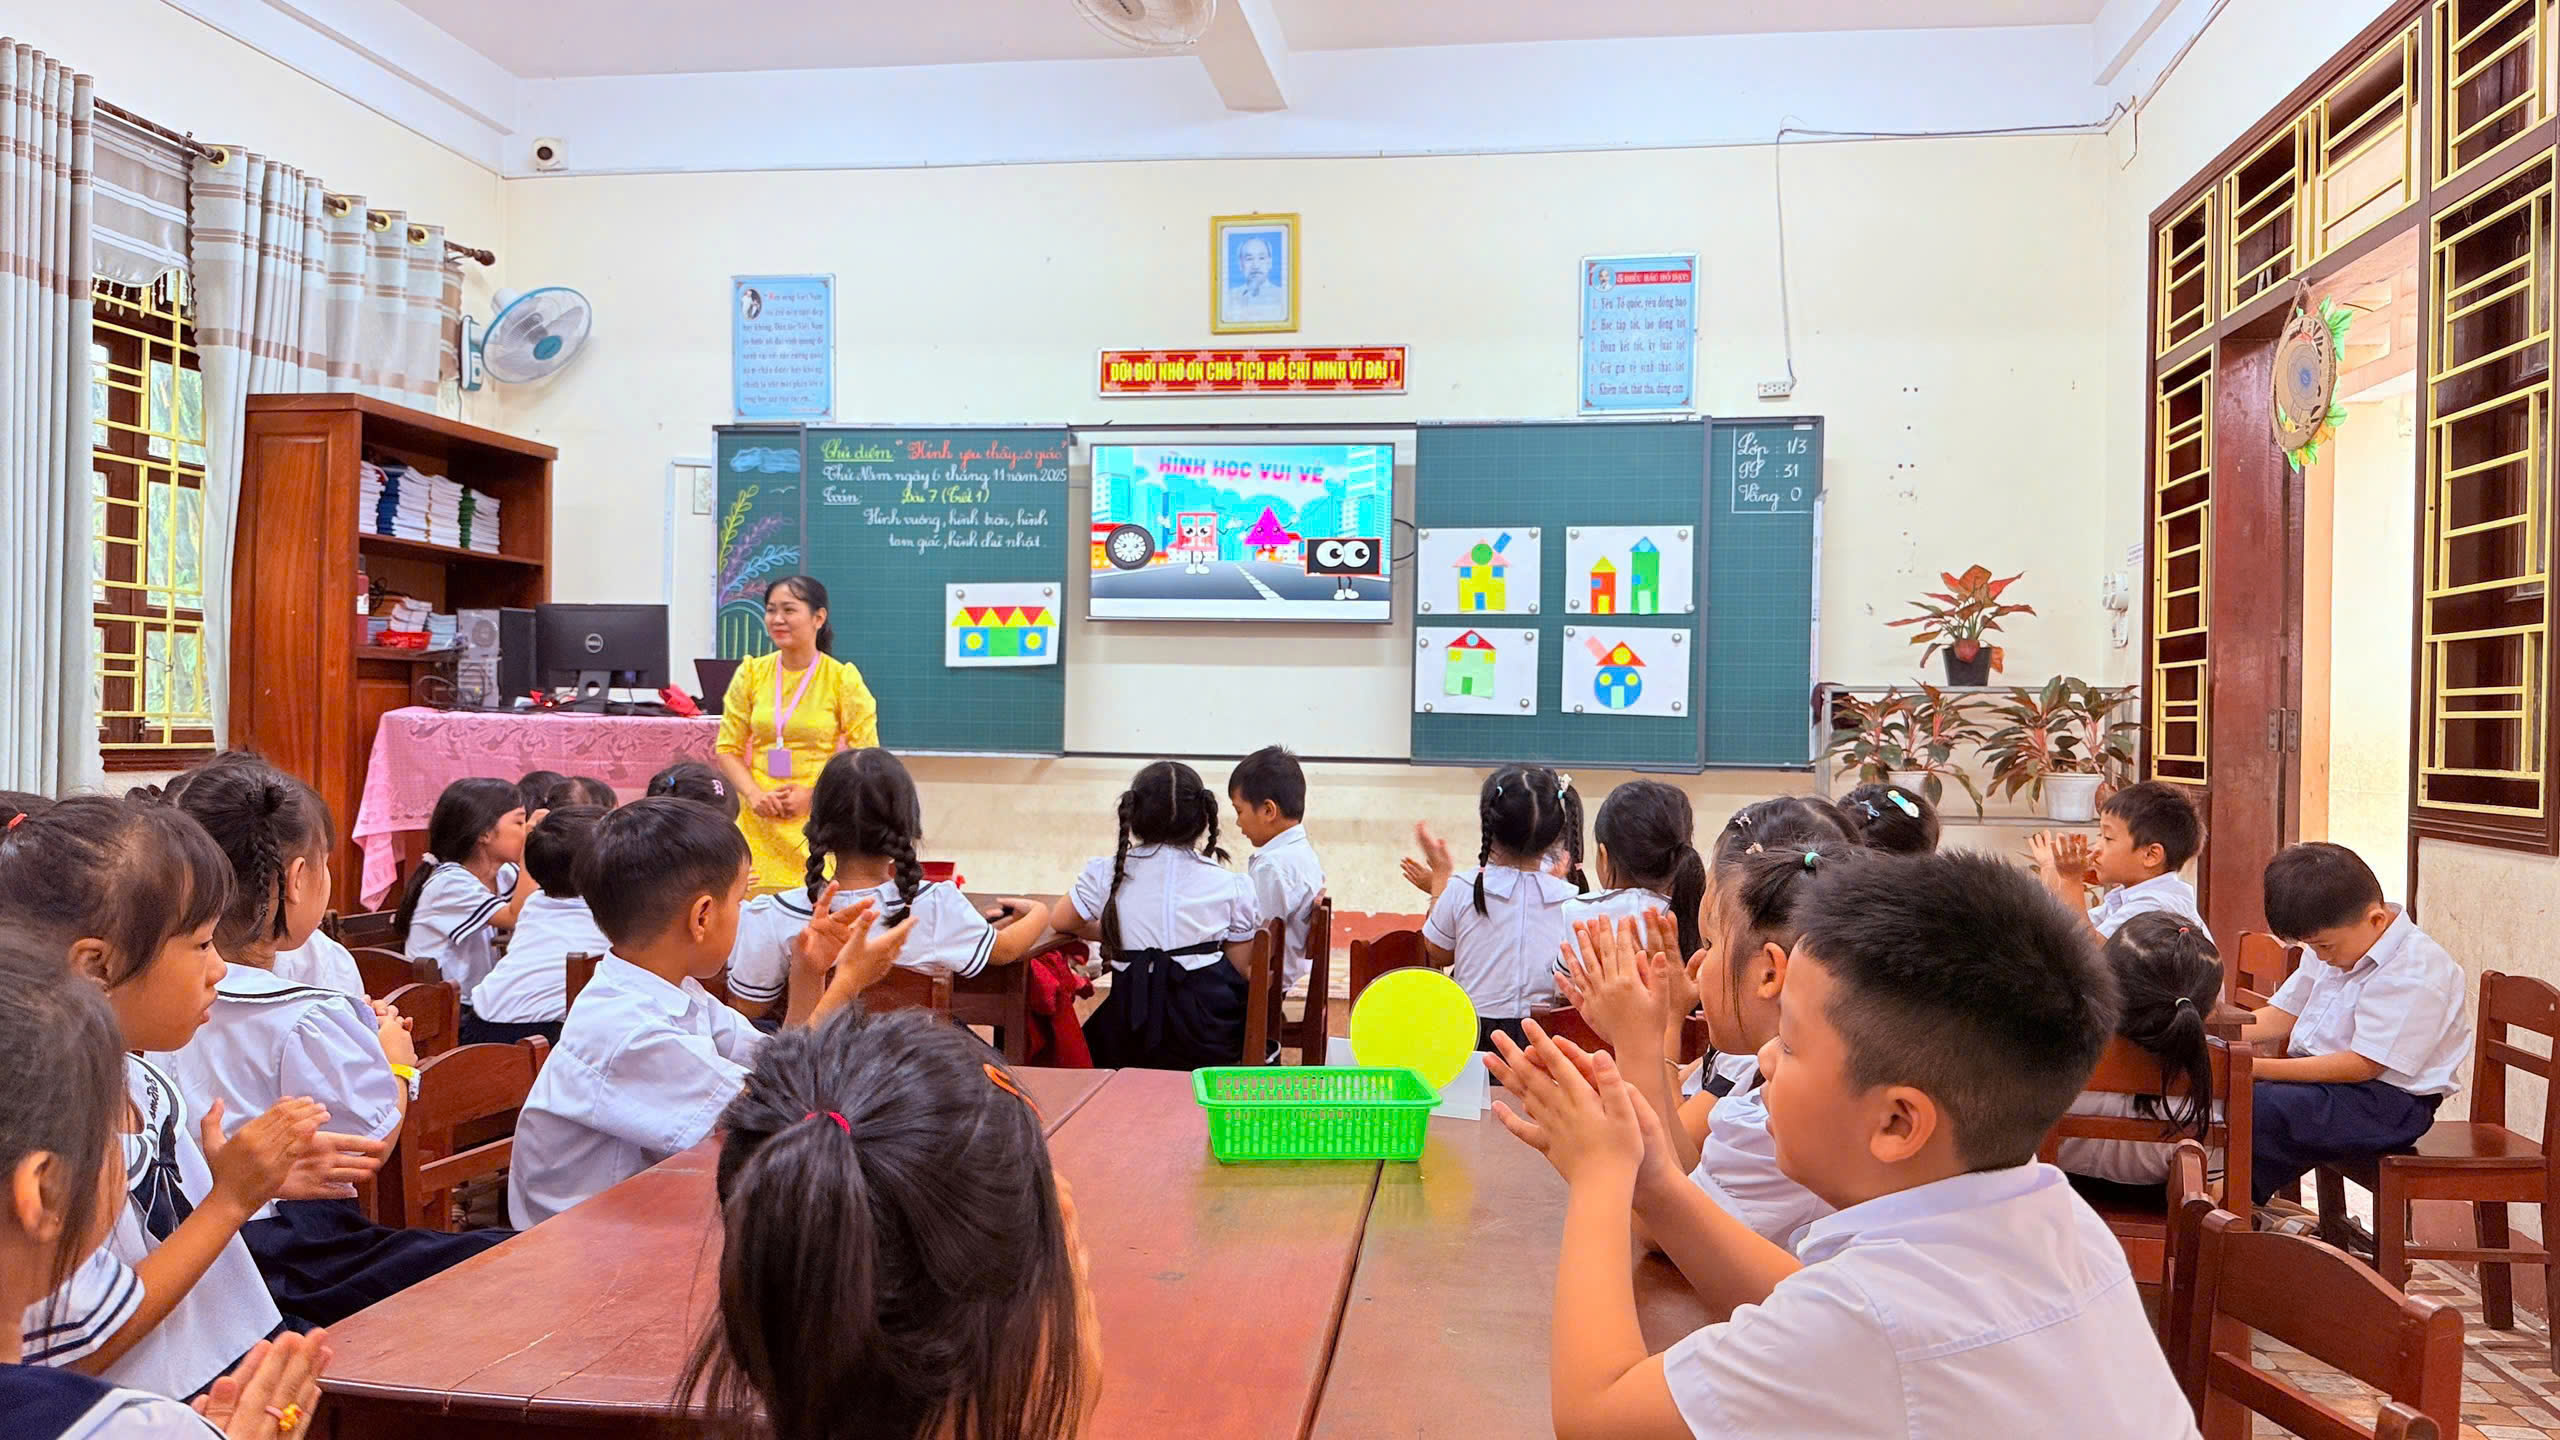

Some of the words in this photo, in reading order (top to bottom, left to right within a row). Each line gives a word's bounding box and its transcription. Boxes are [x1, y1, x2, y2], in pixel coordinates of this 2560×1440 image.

[1206, 355, 1233, 381] CHỦ
[1287, 356, 1311, 380] CHÍ
[1312, 359, 1347, 380] MINH
[1787, 436, 1807, 454] 1/3
[1159, 451, 1206, 475] HÌNH
[1212, 459, 1252, 480] HỌC
[1260, 463, 1291, 481] VUI
[1783, 463, 1799, 478] 31
[894, 468, 930, 489] ngày
[931, 467, 941, 481] 6
[945, 463, 990, 490] tháng
[992, 468, 1005, 481] 11
[1006, 470, 1037, 482] năm
[1039, 468, 1067, 482] 2025
[928, 488, 938, 503] 7
[975, 487, 990, 504] 1)
[863, 507, 902, 525] Hình
[949, 508, 979, 526] hình
[1017, 508, 1049, 526] hình
[889, 533, 914, 547] tam
[947, 530, 978, 548] hình
